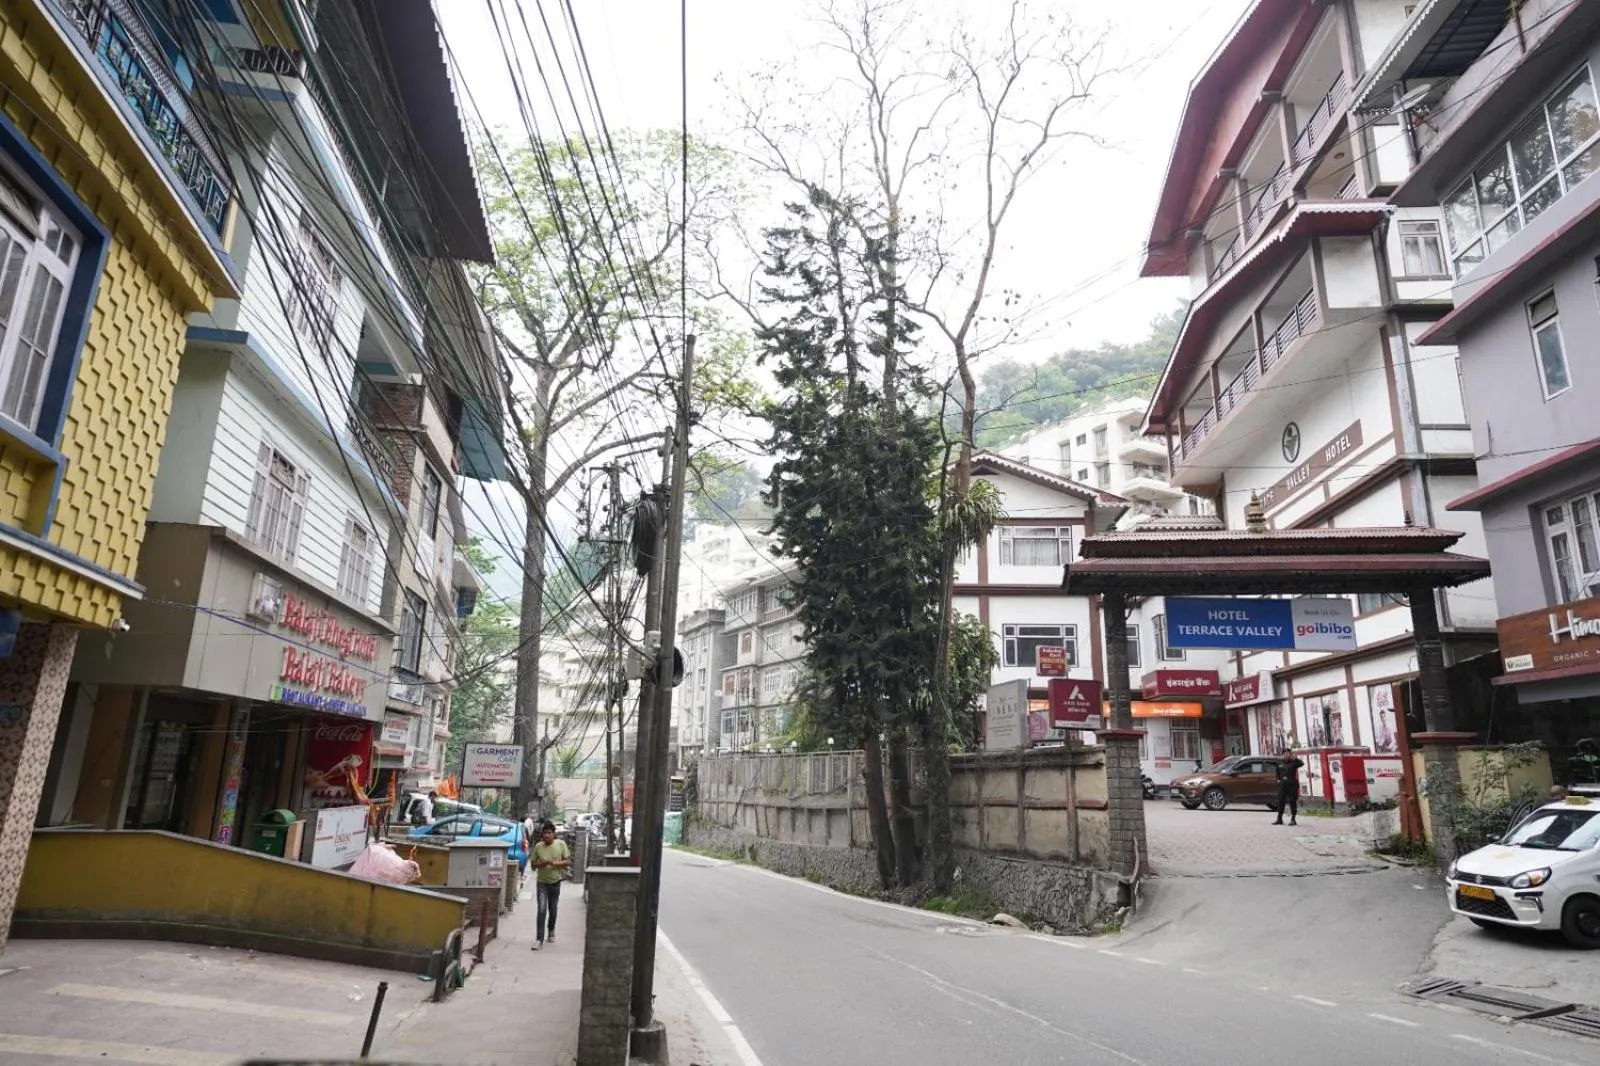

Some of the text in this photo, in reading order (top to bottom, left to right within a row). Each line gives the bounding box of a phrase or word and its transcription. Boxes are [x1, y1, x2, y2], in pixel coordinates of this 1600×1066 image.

[1286, 463, 1311, 490] VALLEY
[1325, 434, 1351, 461] HOTEL
[280, 591, 322, 644] Balaji
[1208, 610, 1249, 621] HOTEL
[1177, 625, 1282, 637] TERRACE VALLEY
[1296, 622, 1352, 636] goibibo
[1553, 650, 1590, 662] ORGANIC
[281, 644, 367, 703] Balaji Bakery
[477, 747, 519, 755] GARMENT
